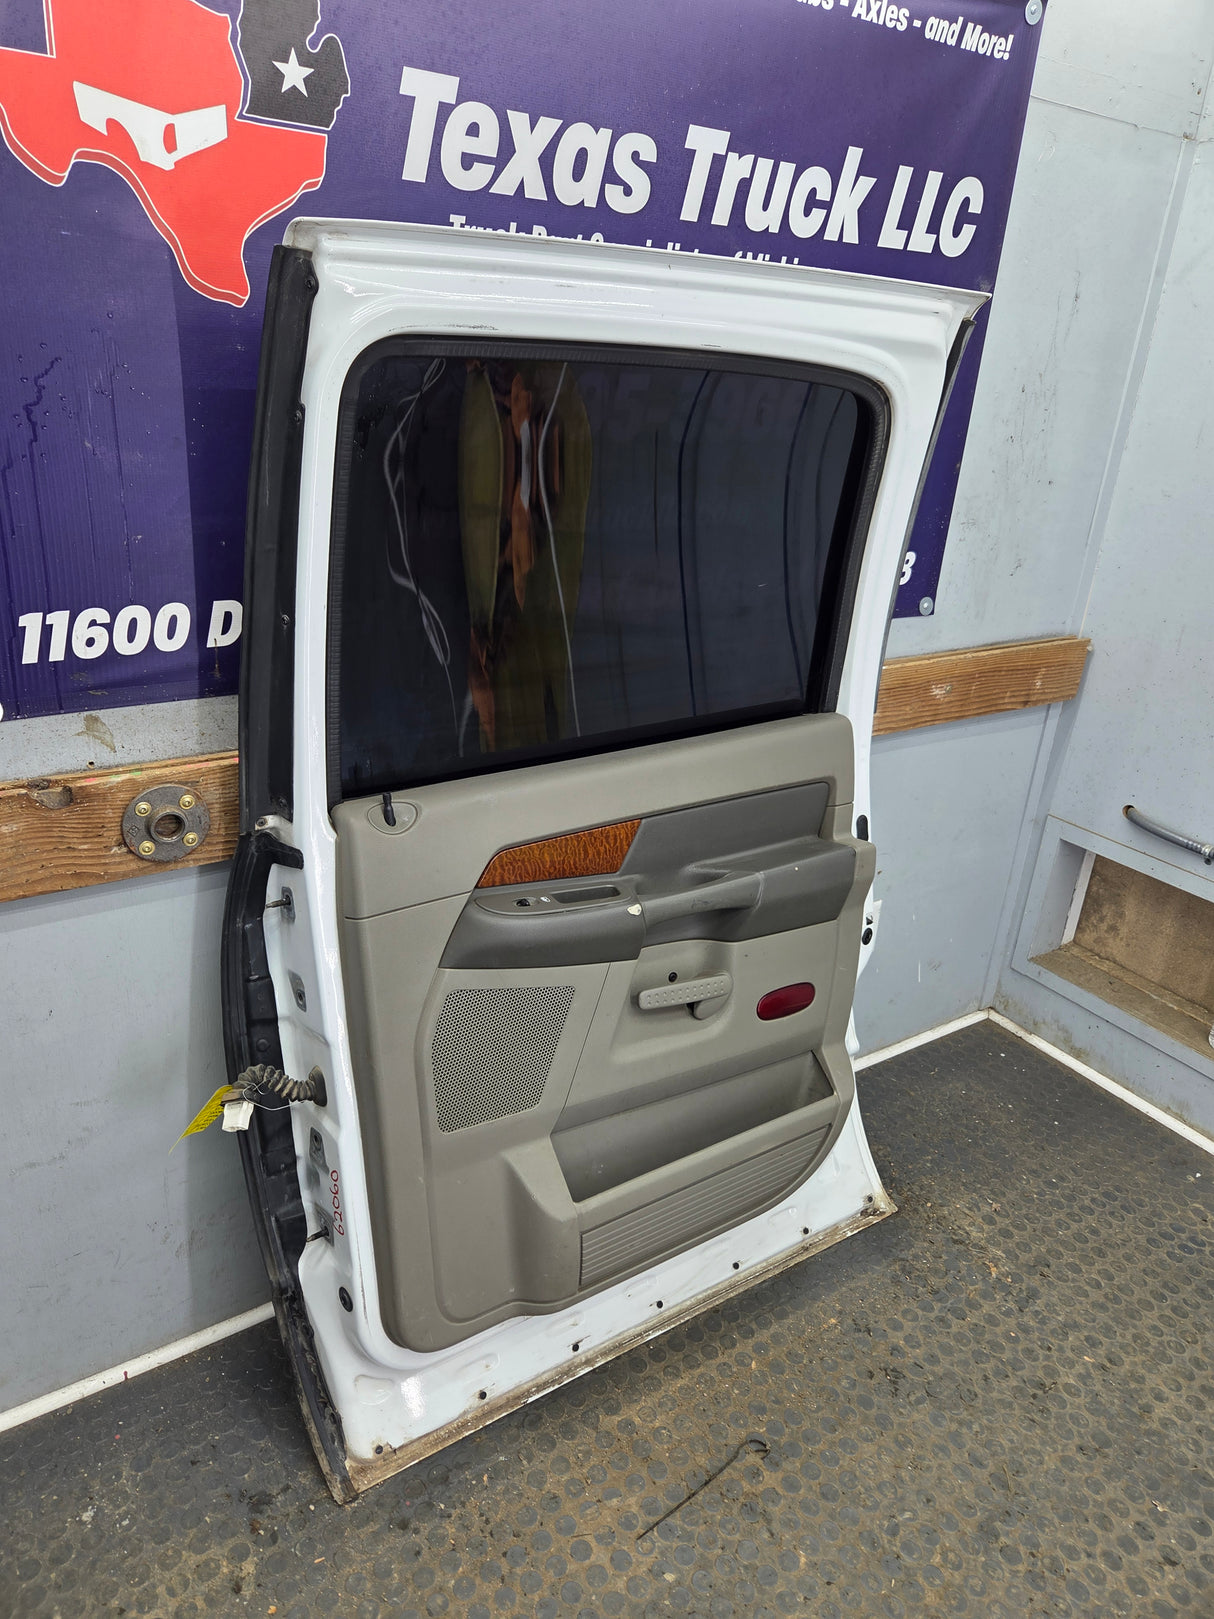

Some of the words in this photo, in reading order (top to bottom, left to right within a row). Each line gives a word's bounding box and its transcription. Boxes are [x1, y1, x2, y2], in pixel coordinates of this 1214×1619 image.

[851, 0, 910, 31] Axles
[924, 16, 964, 46] and
[960, 22, 1015, 60] More!
[399, 66, 658, 215] Texas
[679, 124, 878, 244] Truck
[876, 164, 985, 259] LLC
[18, 602, 191, 665] 11600
[329, 1169, 345, 1236] 62060
